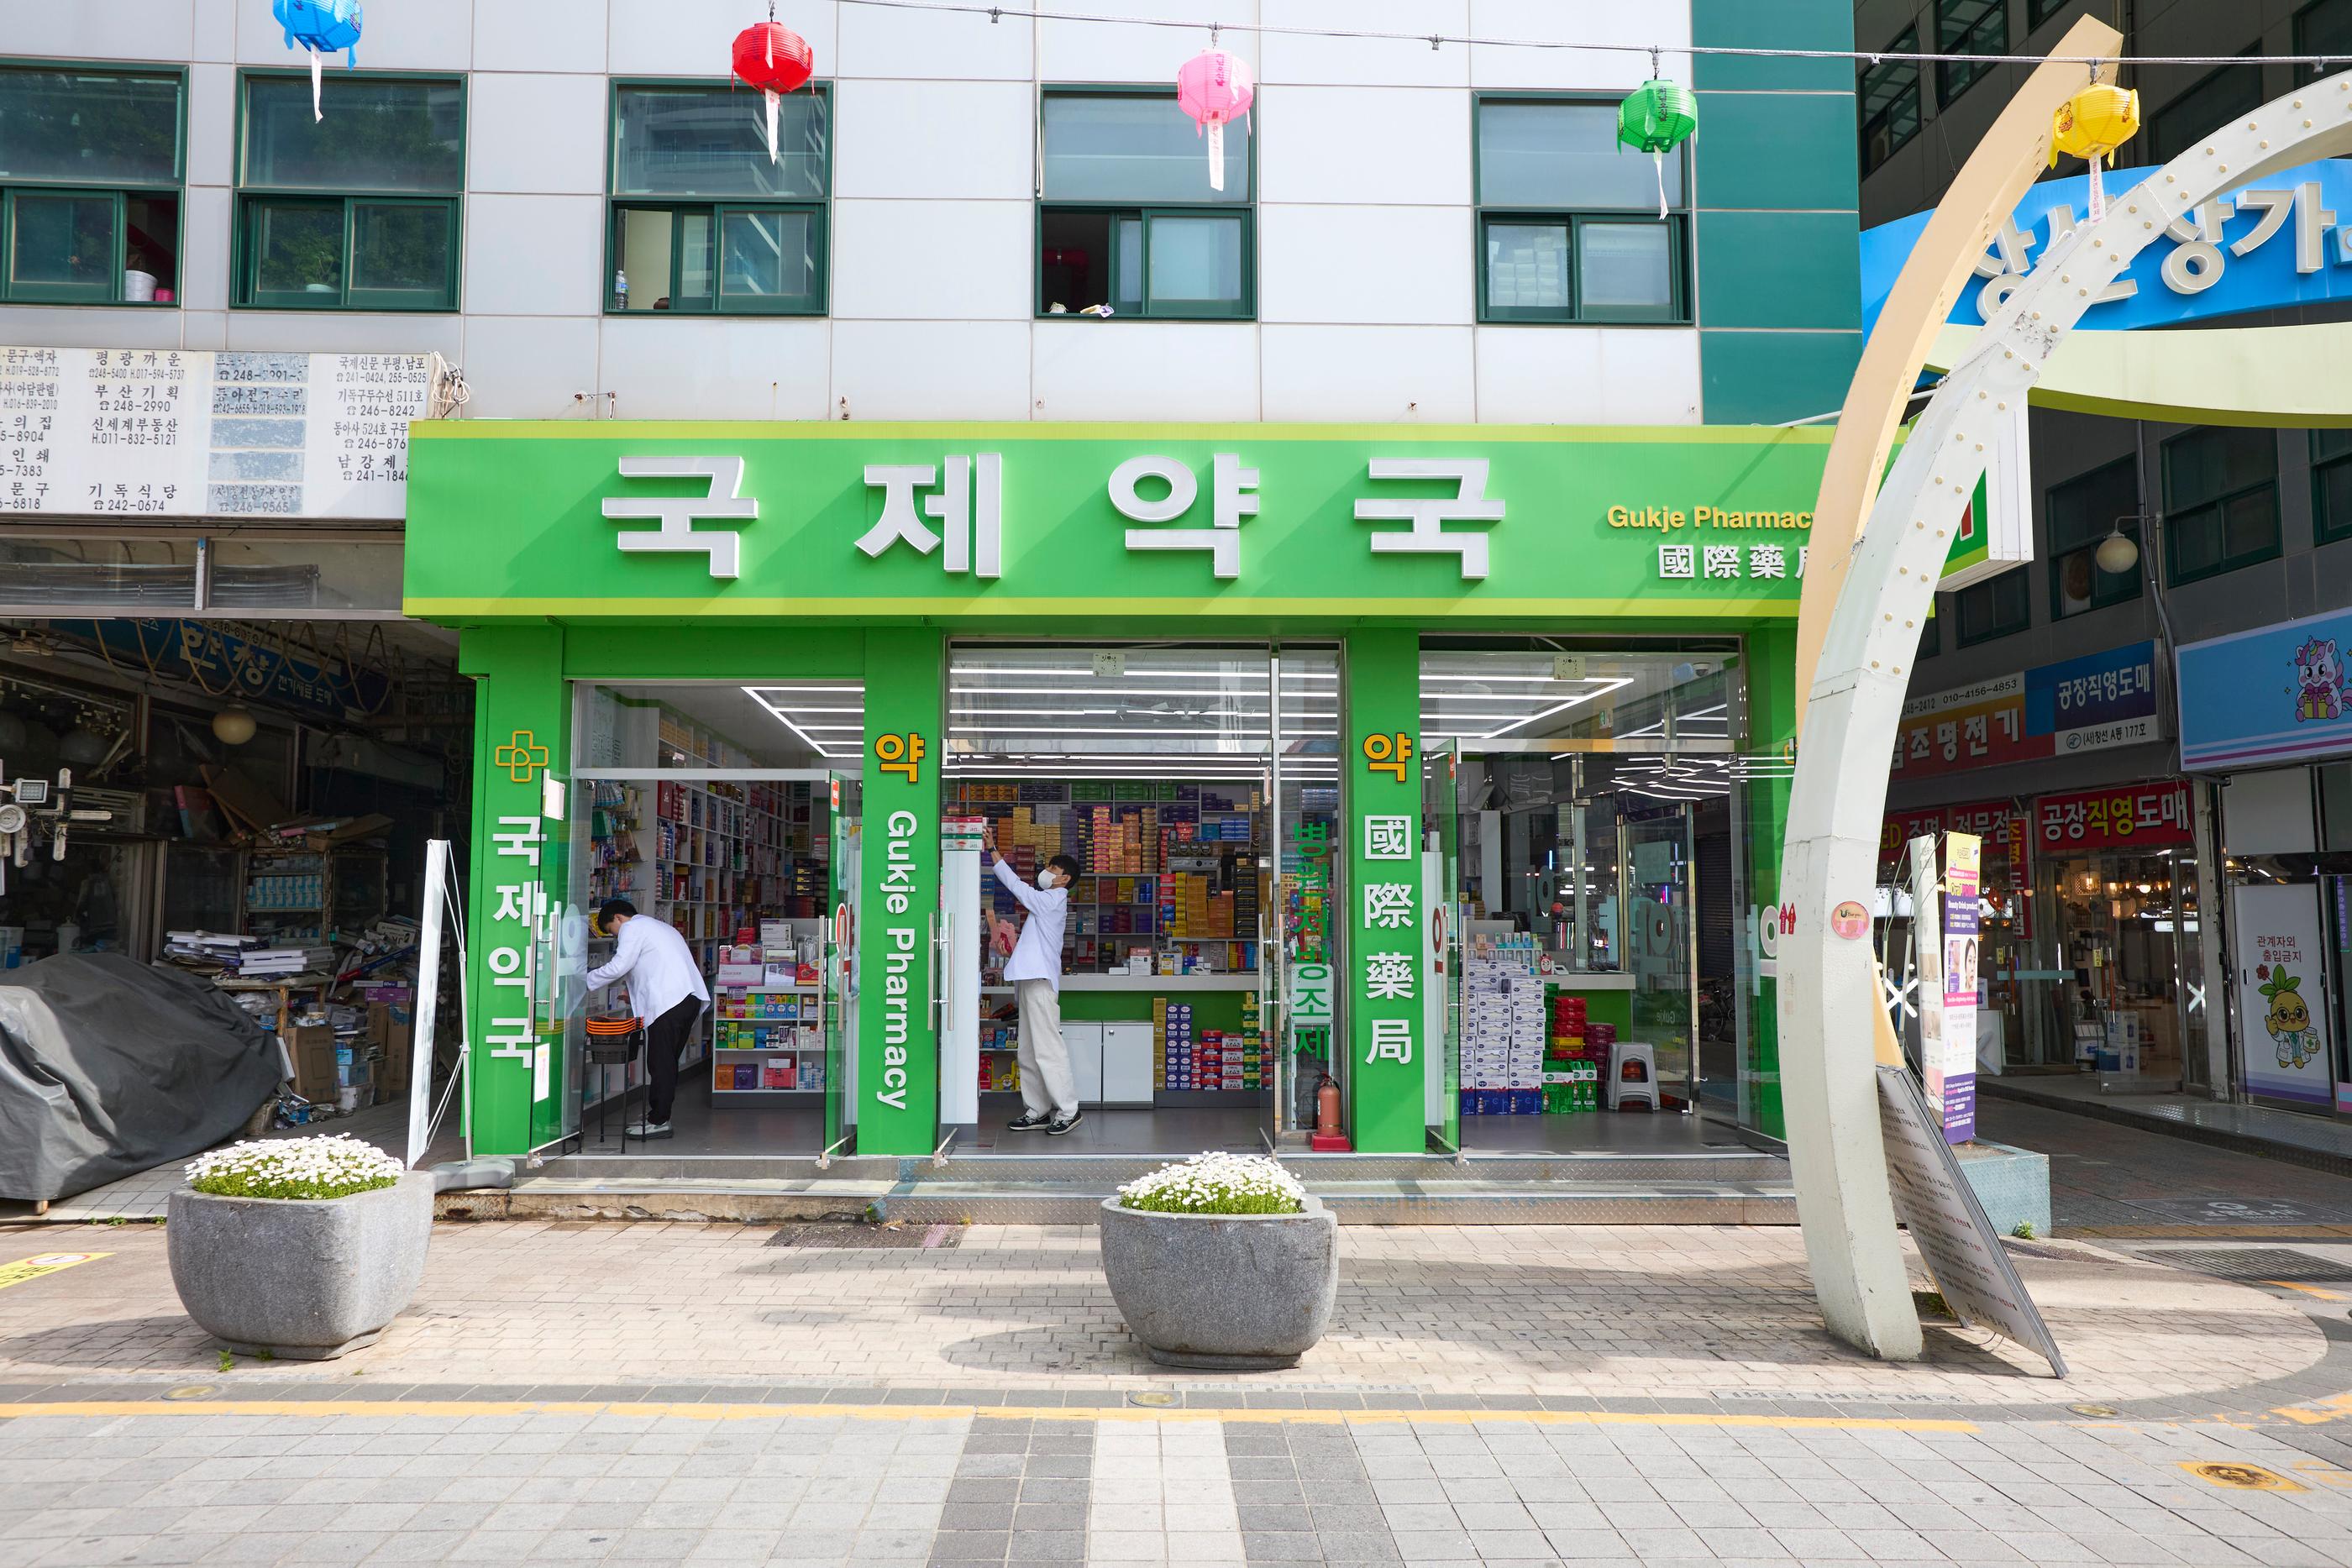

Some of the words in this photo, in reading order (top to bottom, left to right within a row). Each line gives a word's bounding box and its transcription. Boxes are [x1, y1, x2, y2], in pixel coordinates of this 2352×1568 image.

[339, 356, 378, 370] 국제신문
[389, 372, 427, 383] 255-0525
[338, 389, 393, 402] 기독구두수선
[396, 390, 423, 402] 511호
[113, 401, 171, 412] 248-2990
[360, 405, 415, 417] 246-8242
[92, 417, 178, 433] 신세계부동산
[333, 421, 360, 436] 동아사
[362, 422, 387, 435] 524호
[92, 433, 176, 445] H.011-832-5121
[108, 500, 165, 511] 242-0674
[233, 501, 288, 512] 246-9565
[1607, 506, 1685, 532] Gukje
[1943, 679, 2017, 704] 010-4156-4853
[2059, 663, 2150, 710] 공장직영도매
[2110, 726, 2123, 741] A동
[2125, 723, 2146, 738] 177호
[874, 733, 925, 784] 약
[1362, 732, 1413, 783] 약
[2042, 789, 2187, 840] 공장직영도매
[880, 810, 917, 914] Gukje
[1364, 815, 1415, 1065] 國際藥局
[2257, 936, 2296, 947] 관계자외
[2263, 950, 2302, 962] 출입금지
[877, 928, 915, 1109] Pharmacy
